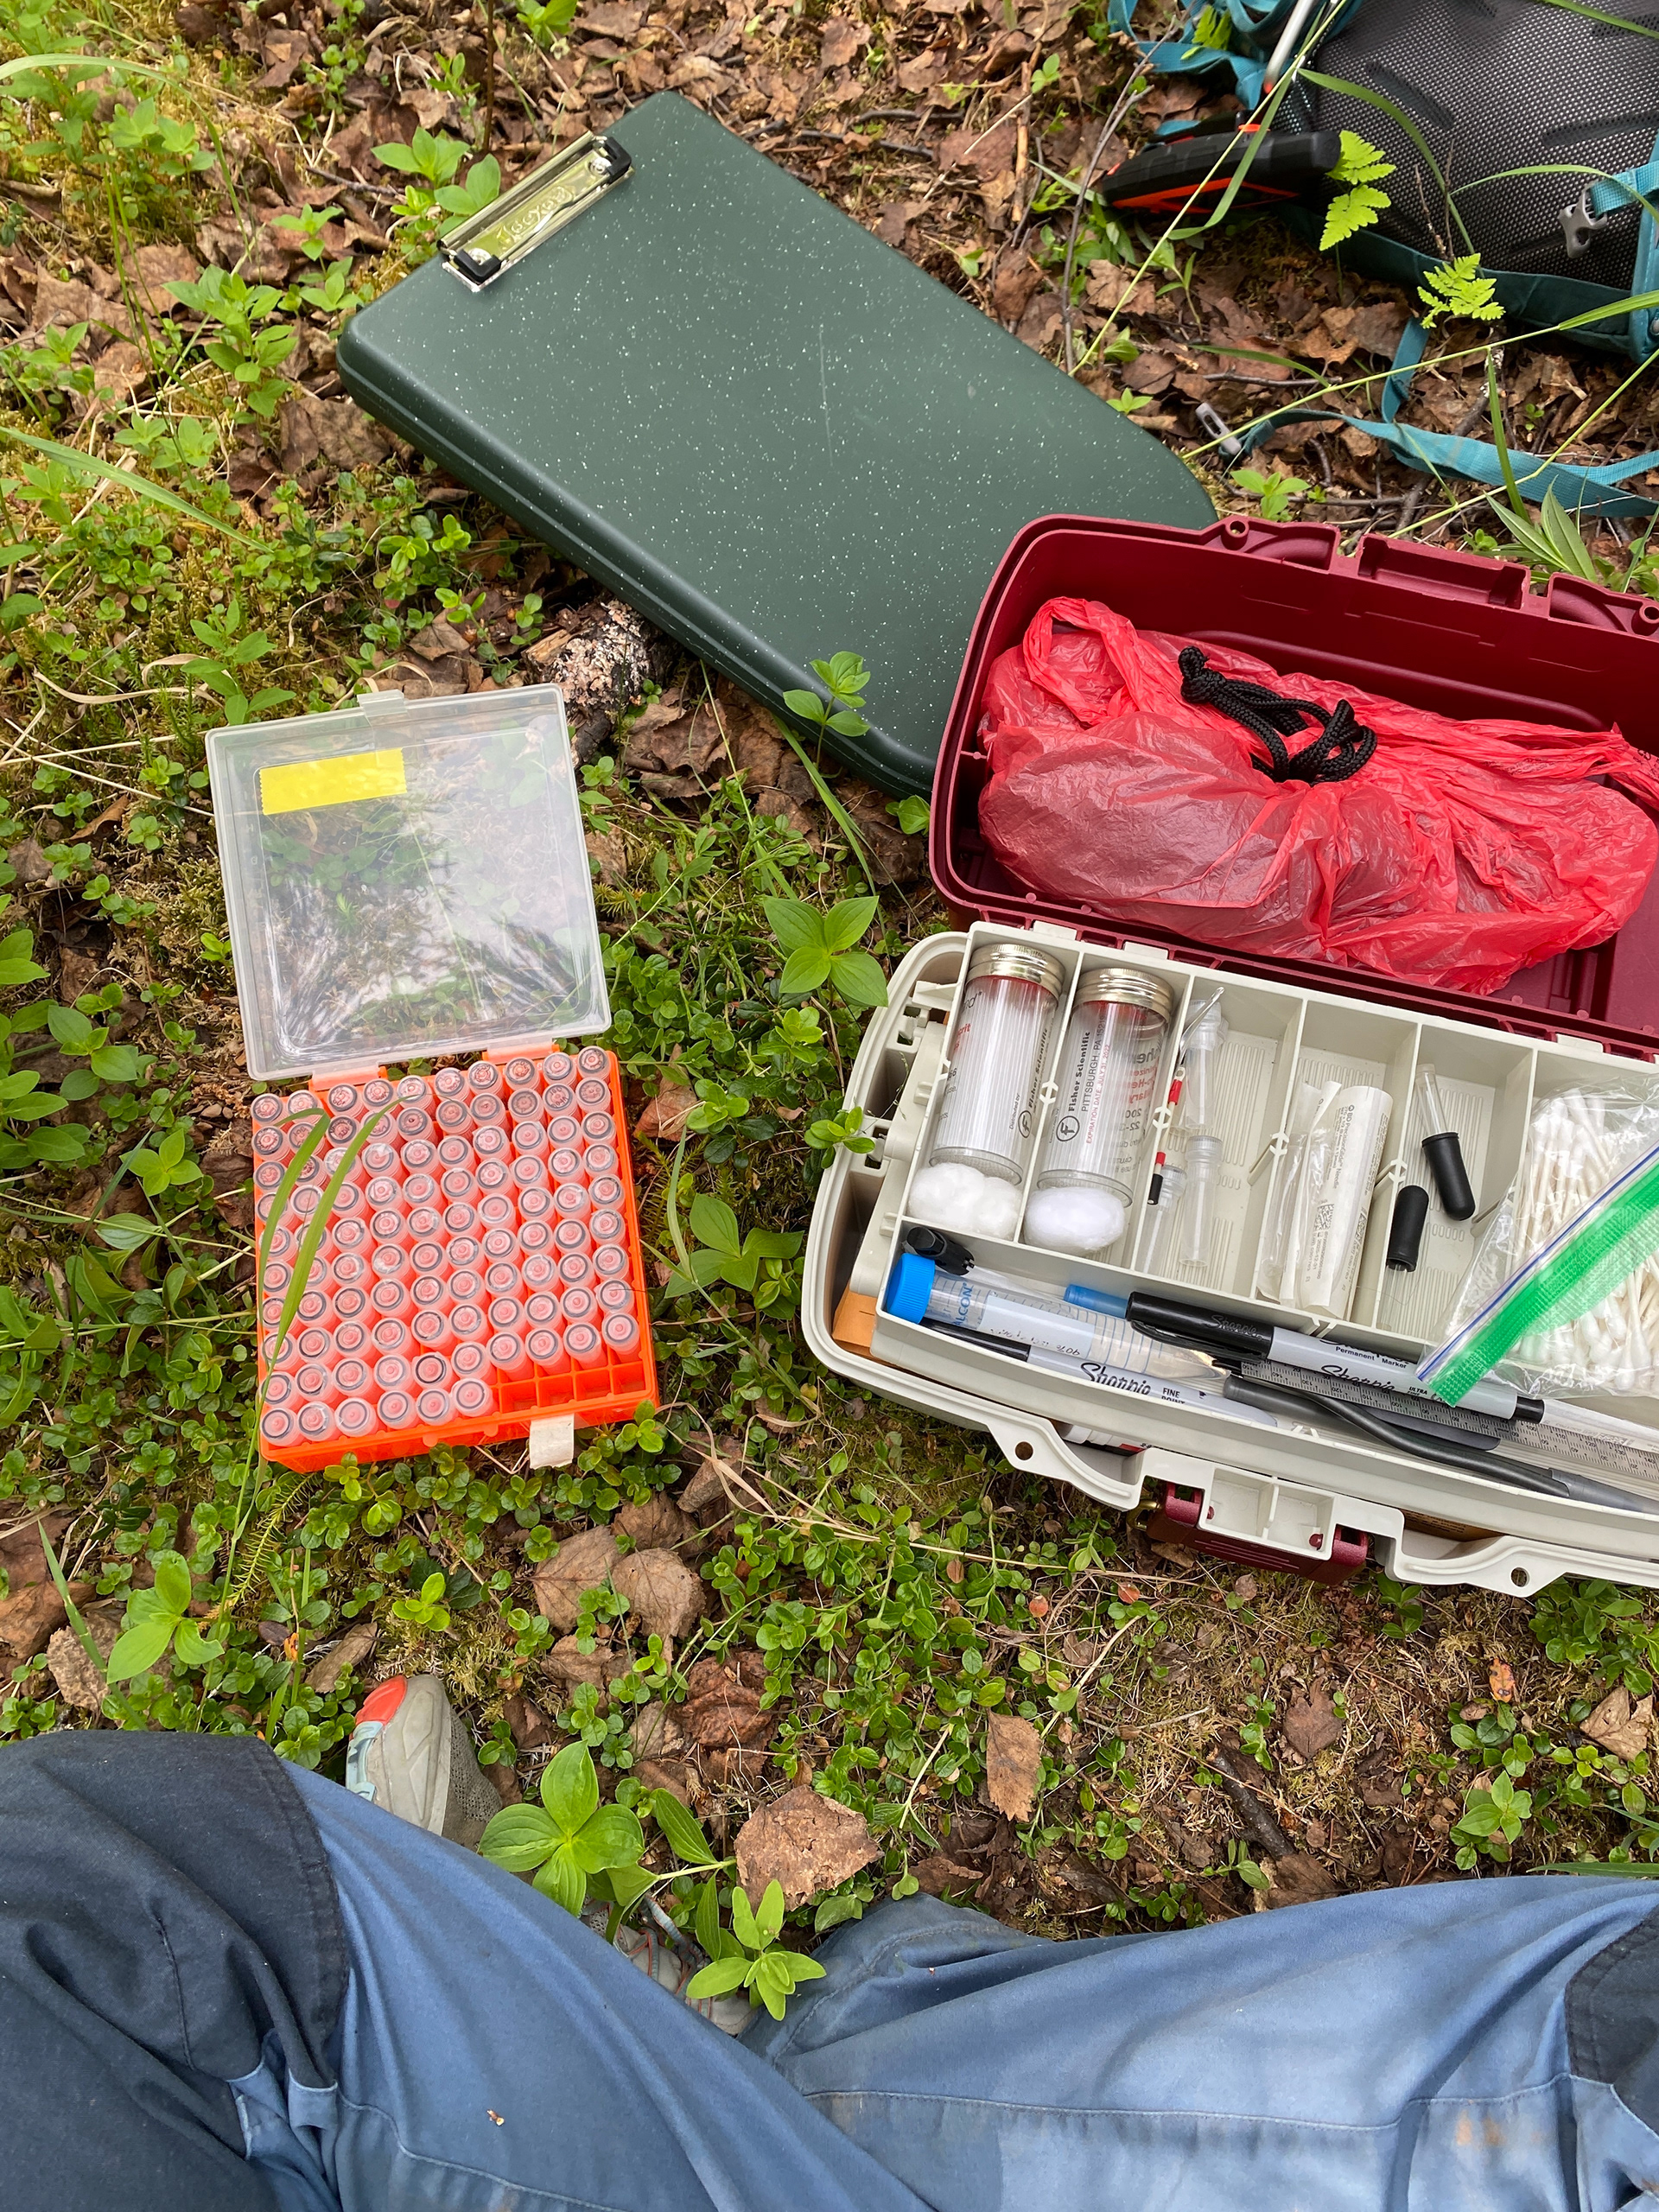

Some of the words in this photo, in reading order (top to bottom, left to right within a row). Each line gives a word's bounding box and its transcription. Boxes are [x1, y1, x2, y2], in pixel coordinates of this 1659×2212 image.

[1093, 1038, 1102, 1050] PA
[1027, 1077, 1039, 1109] Fisher
[1035, 1027, 1048, 1074] Scientific
[1068, 1080, 1081, 1112] Fisher
[1077, 1032, 1090, 1077] Scientific
[1086, 1106, 1098, 1144] EXPIRATION
[1098, 1070, 1107, 1087] JULY
[1346, 1112, 1352, 1122] BD
[1211, 1314, 1259, 1338] Sharpie
[1335, 1345, 1376, 1361] Permanent
[1382, 1357, 1408, 1370] Marker
[1162, 1387, 1180, 1399] FINE
[1408, 1386, 1428, 1395] ULTRA
